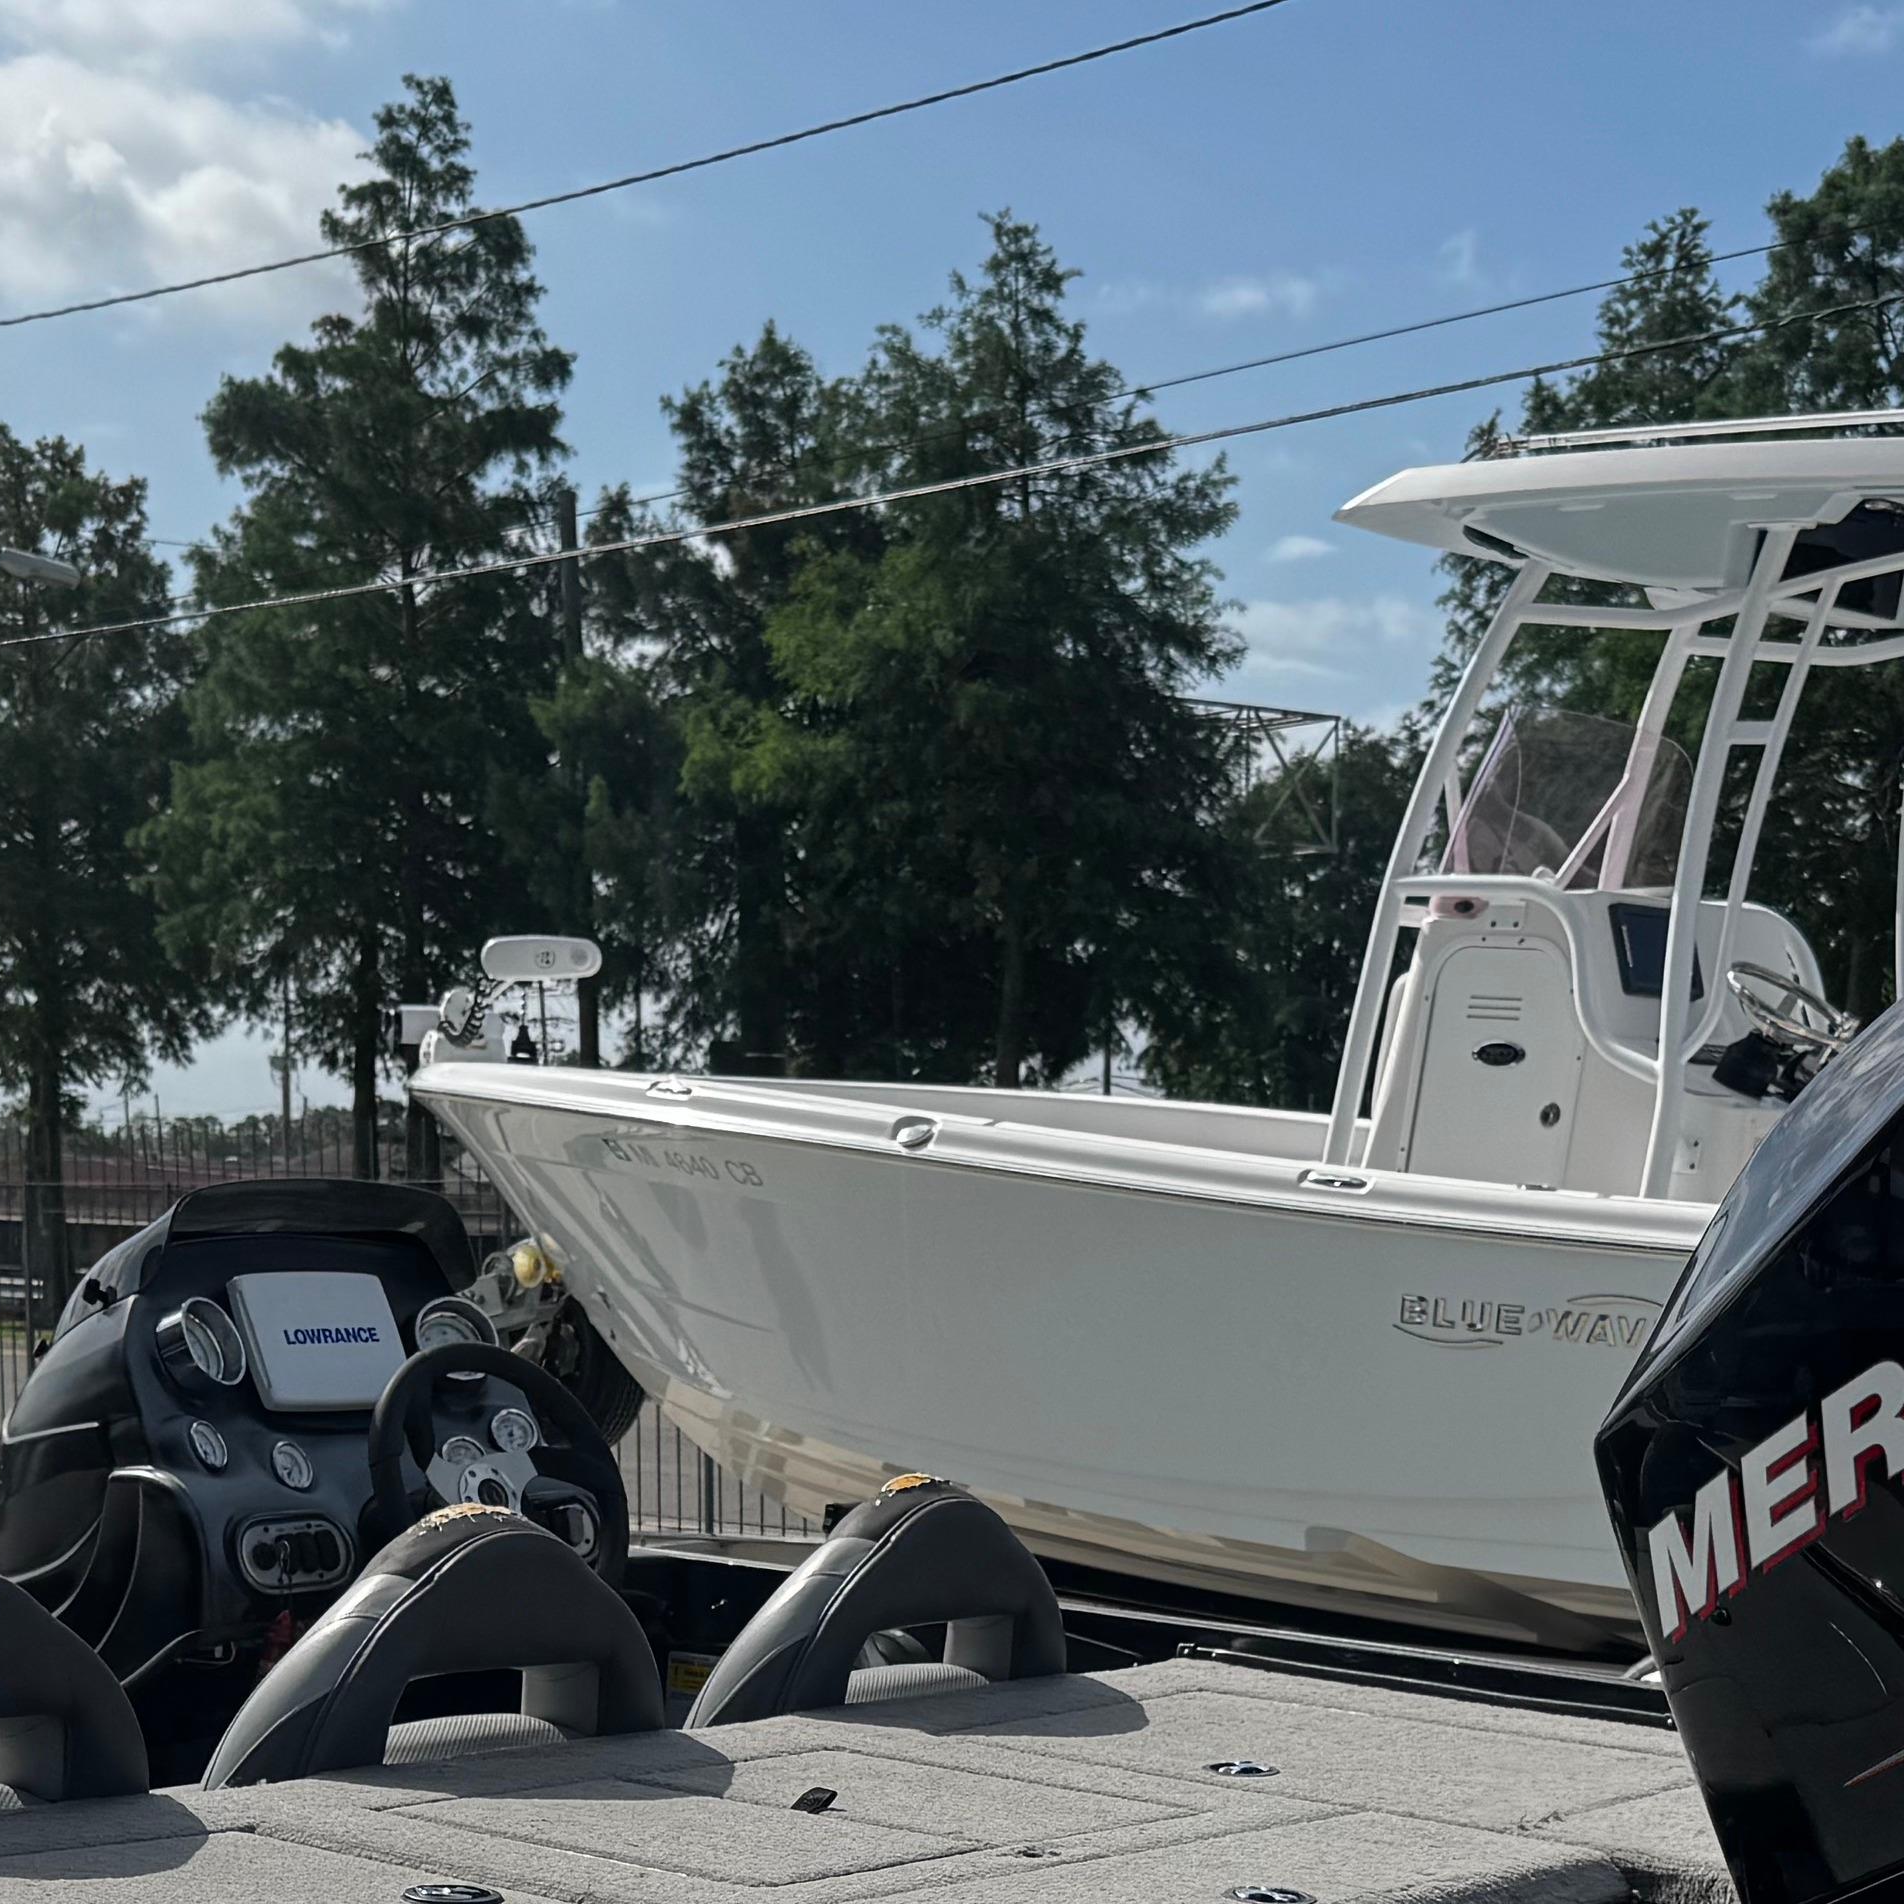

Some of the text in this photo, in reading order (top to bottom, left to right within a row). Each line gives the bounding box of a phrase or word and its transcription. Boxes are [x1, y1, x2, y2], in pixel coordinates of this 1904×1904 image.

[725, 1160, 763, 1186] CB
[1400, 1293, 1657, 1348] BLUE WAV
[283, 1327, 381, 1345] LOWRANCE
